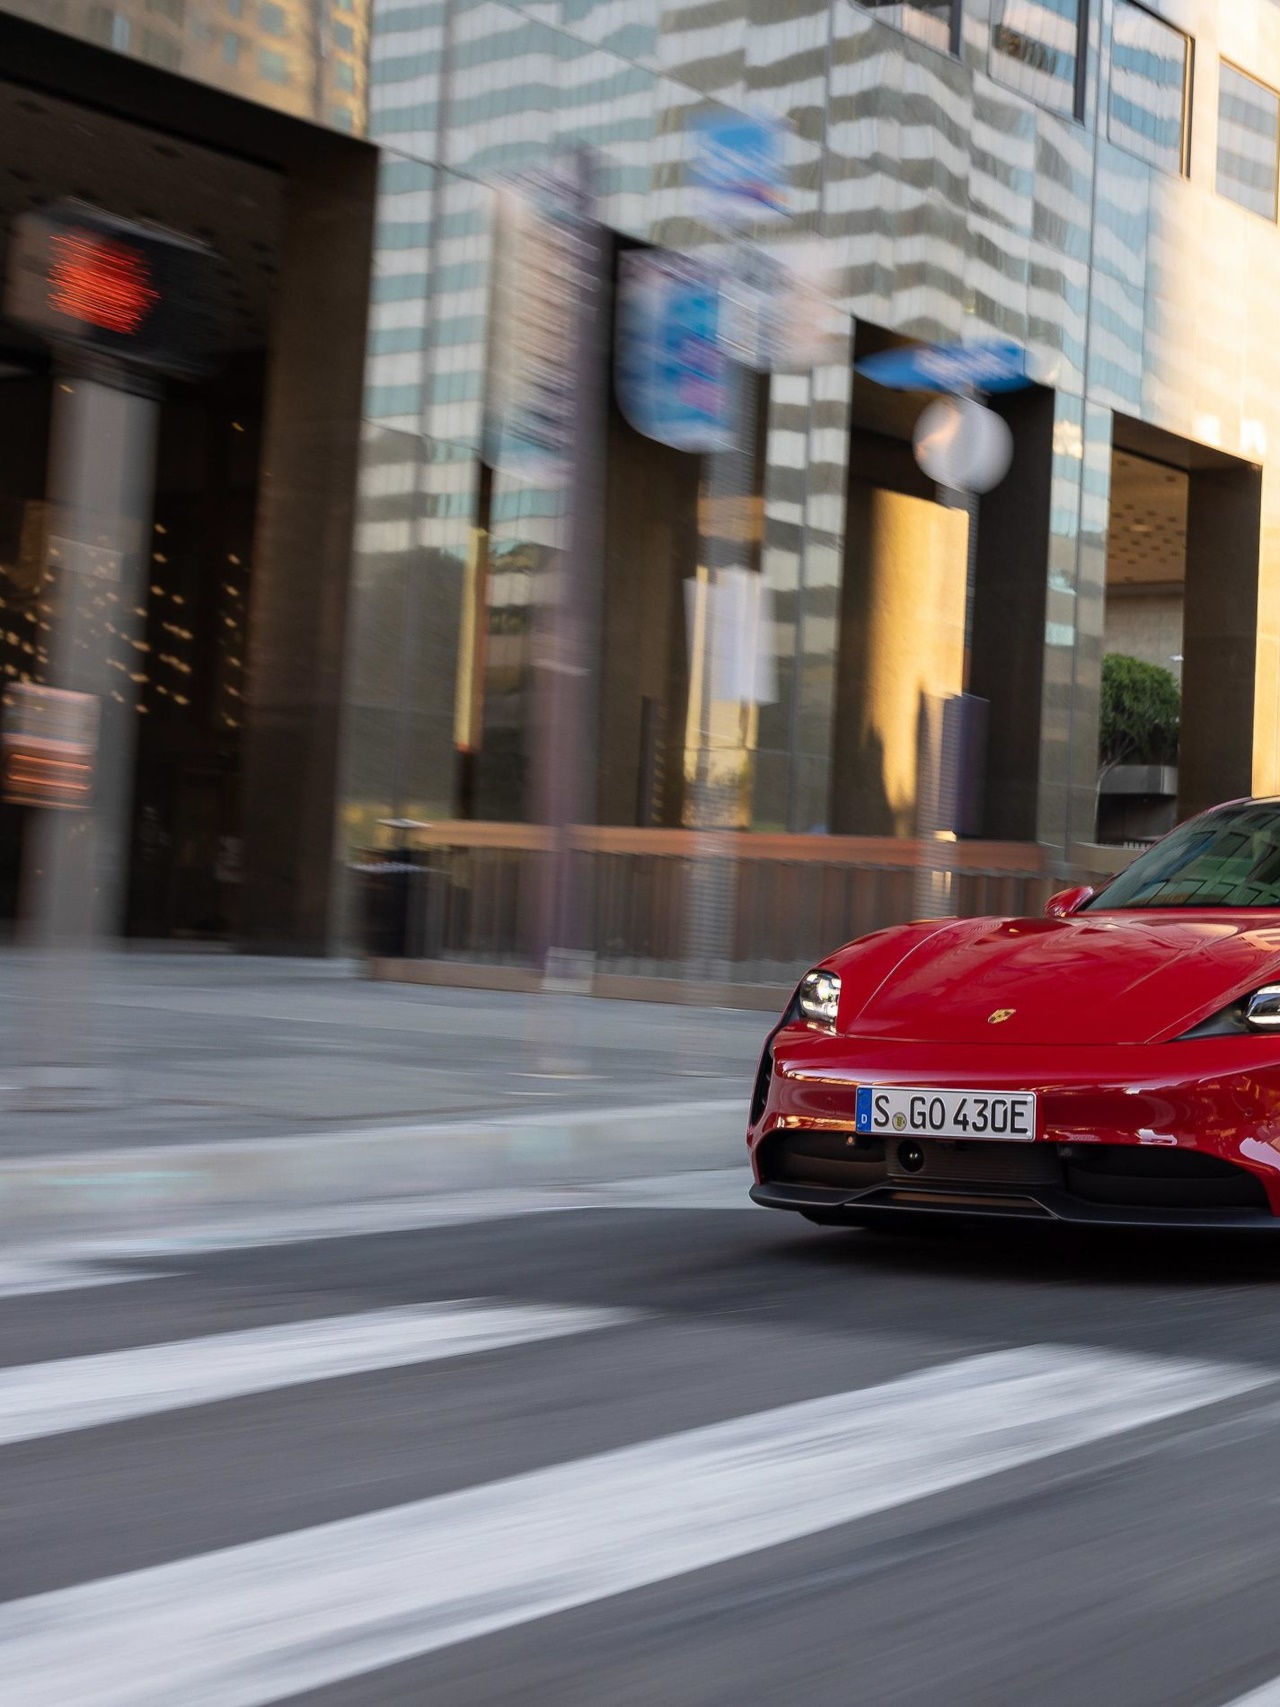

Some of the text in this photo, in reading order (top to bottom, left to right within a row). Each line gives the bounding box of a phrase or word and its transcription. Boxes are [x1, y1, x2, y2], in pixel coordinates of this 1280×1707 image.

[861, 1094, 1029, 1134] D S GO 430E
